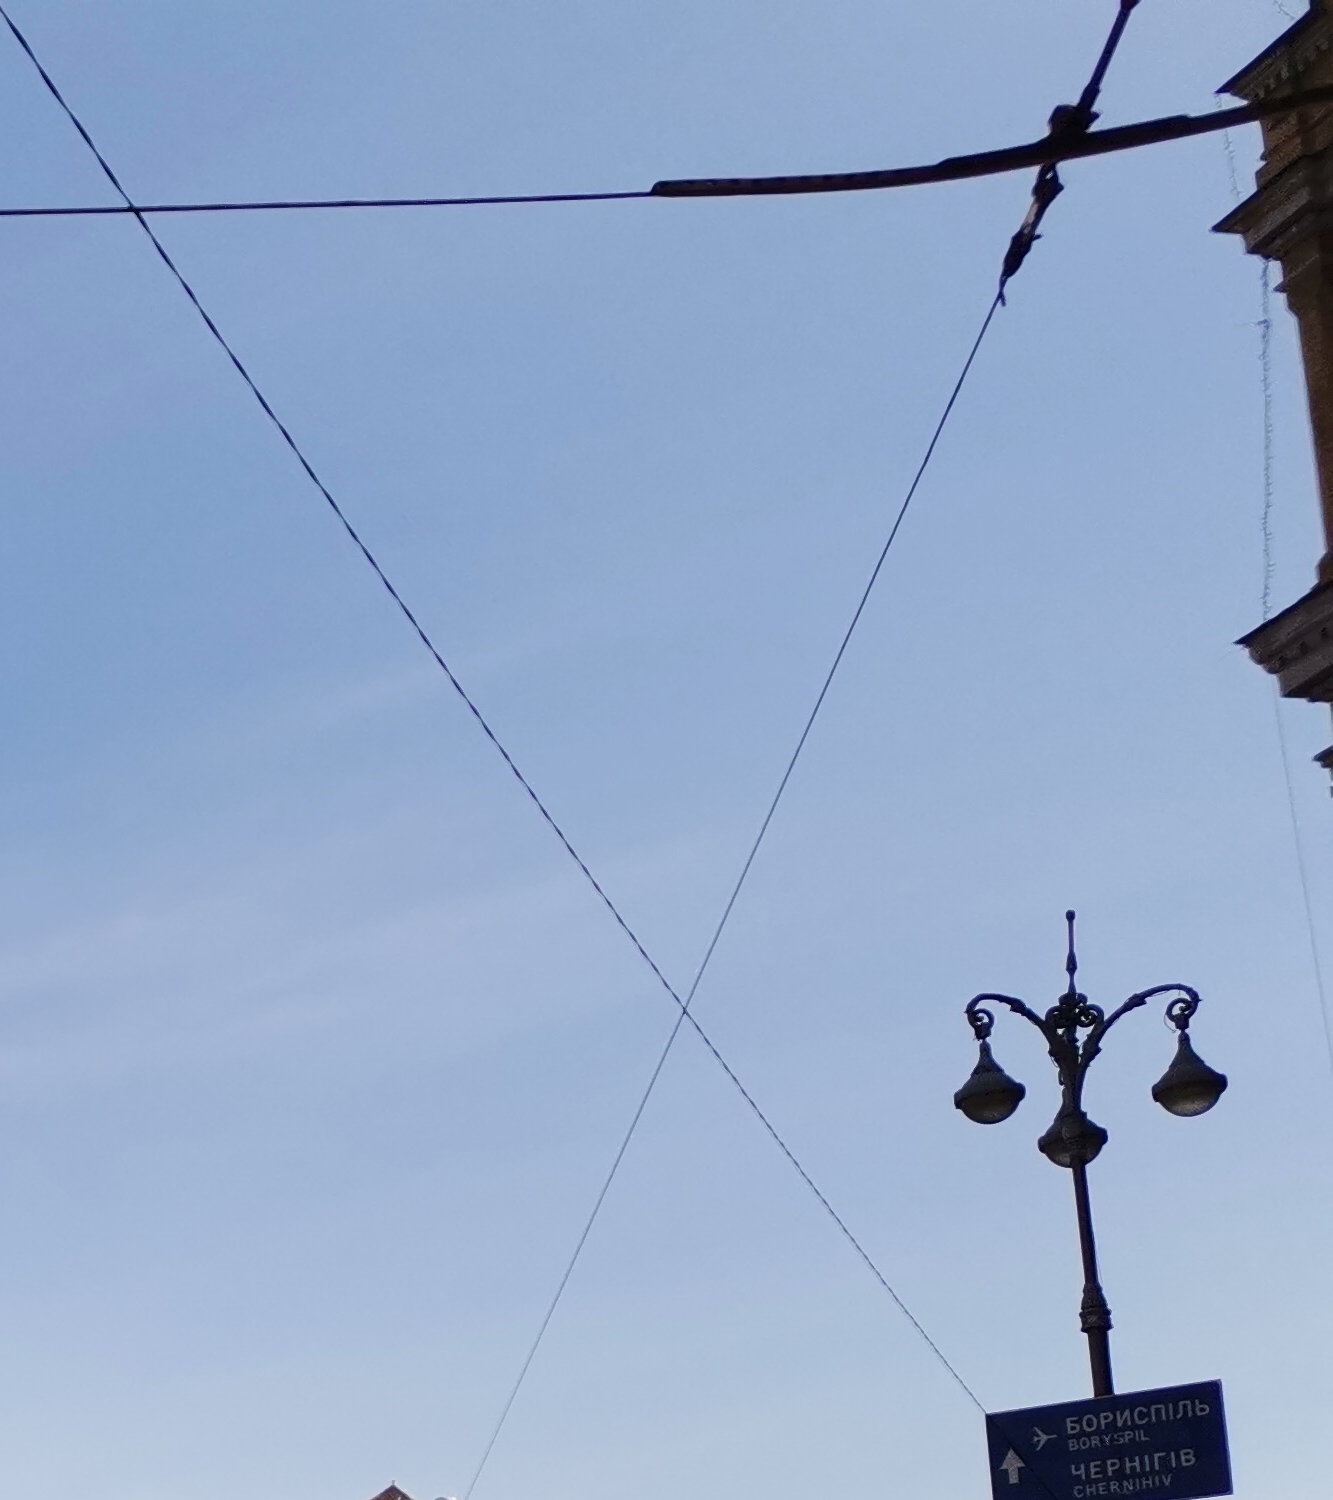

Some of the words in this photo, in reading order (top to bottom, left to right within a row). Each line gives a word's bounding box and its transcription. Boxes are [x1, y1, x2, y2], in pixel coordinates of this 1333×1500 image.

[1066, 1399, 1210, 1435] БОРИСПІЛЬ
[1068, 1430, 1150, 1451] BORYSPIL
[1071, 1448, 1197, 1481] ЧЕРНІГІВ
[1073, 1473, 1174, 1498] CHERNIHIV
